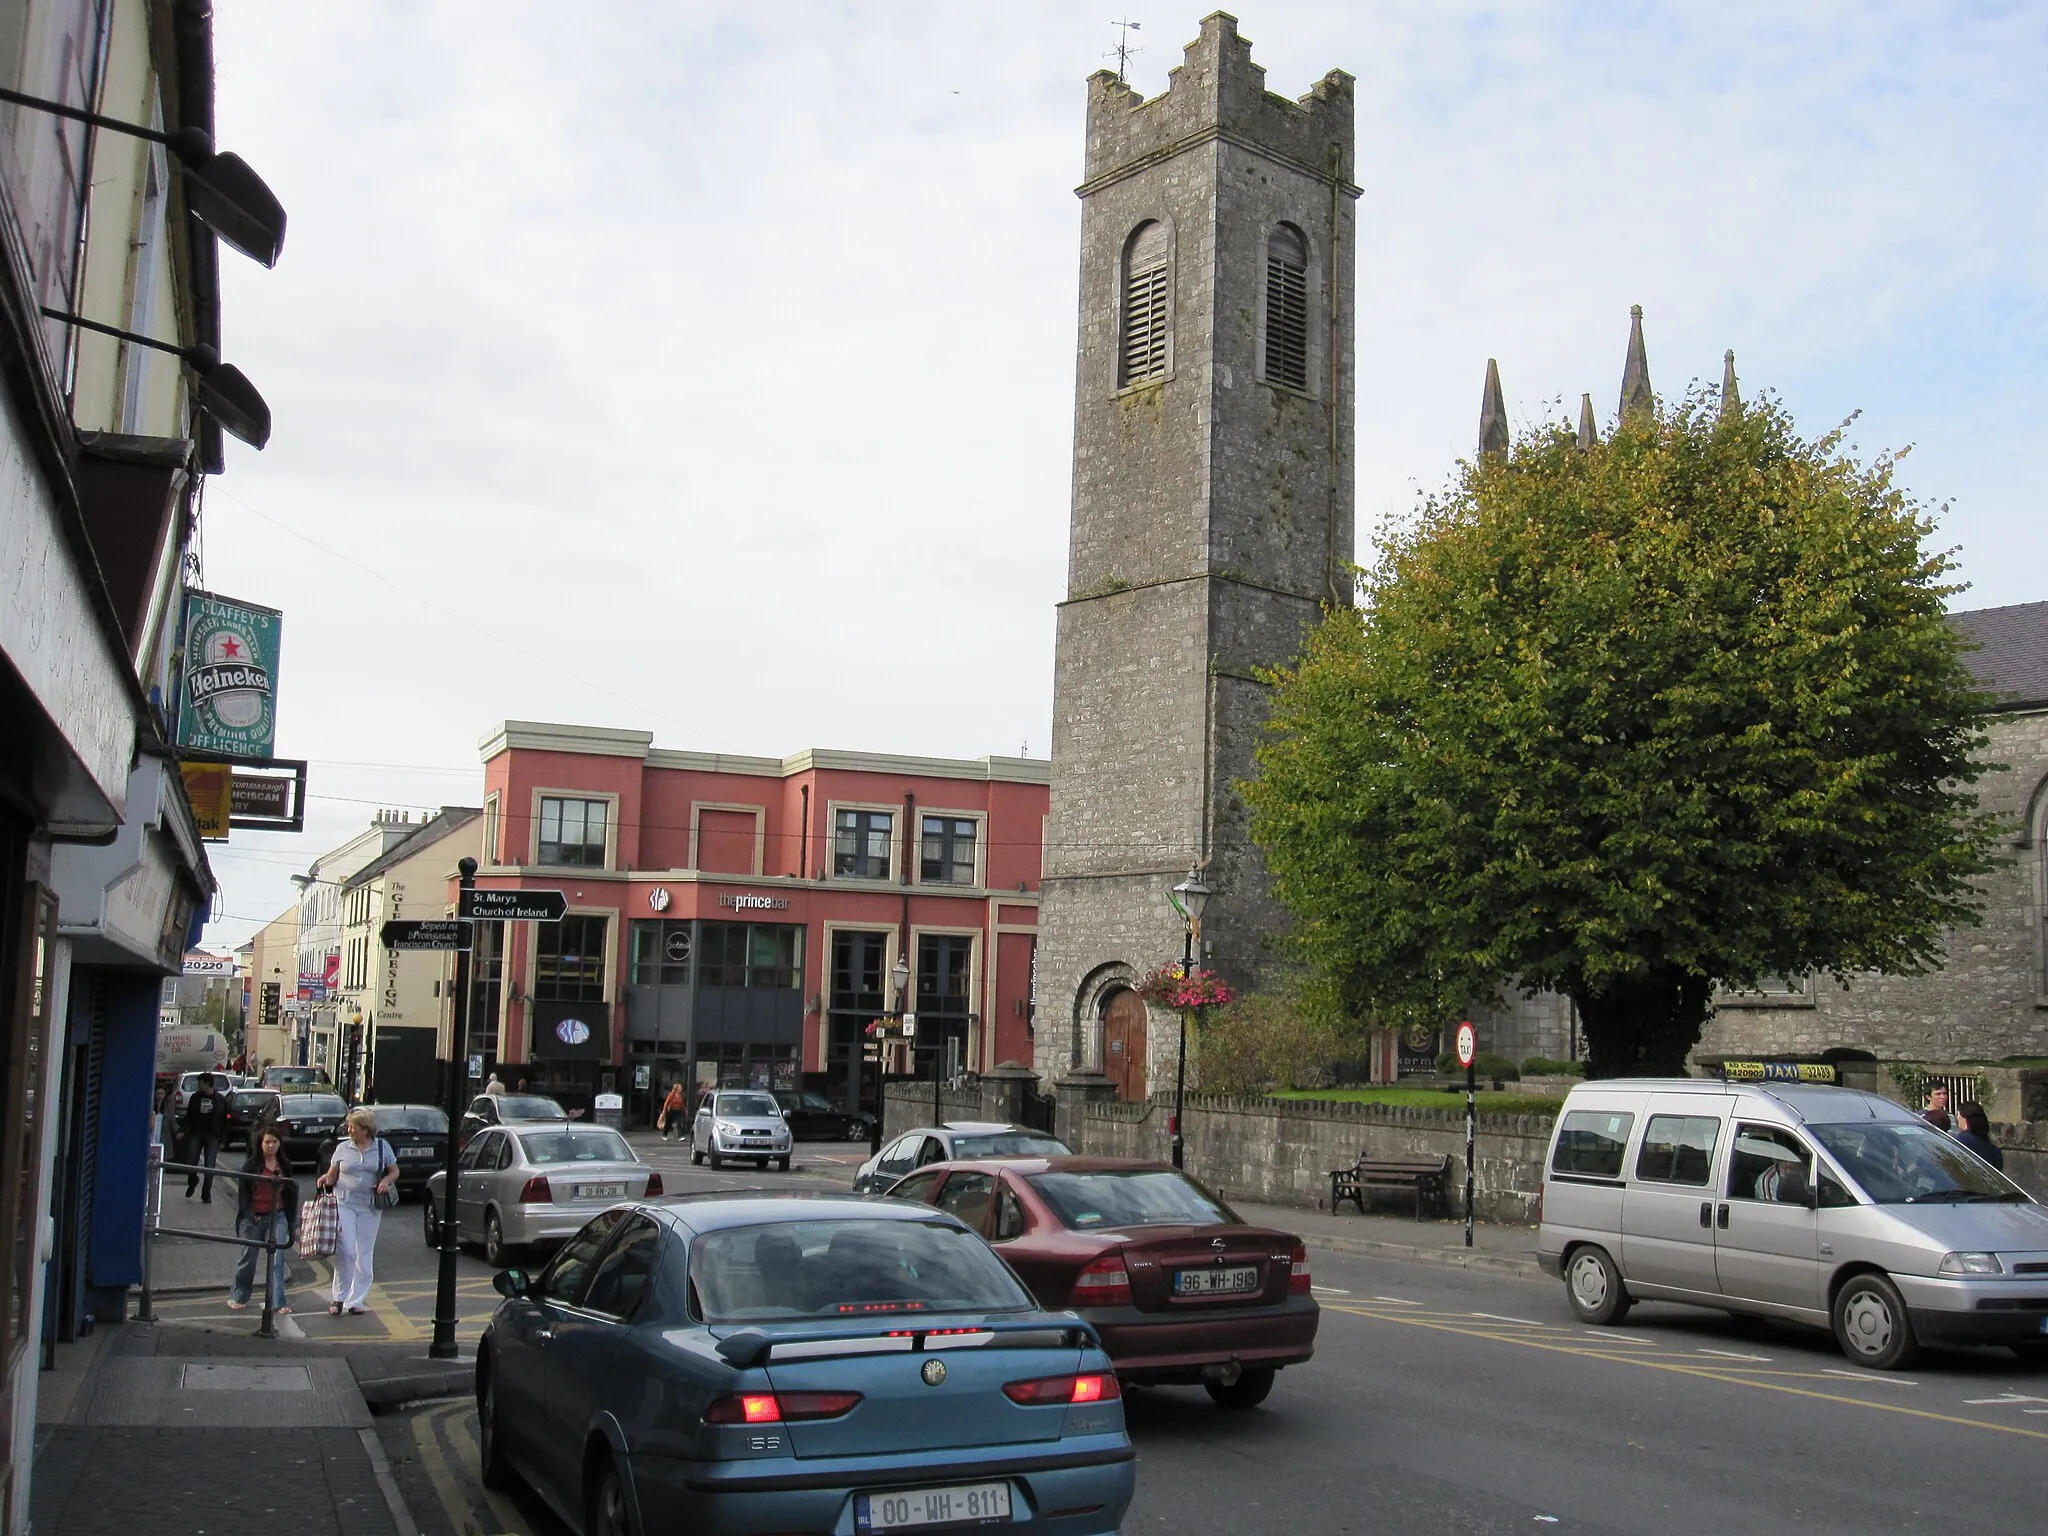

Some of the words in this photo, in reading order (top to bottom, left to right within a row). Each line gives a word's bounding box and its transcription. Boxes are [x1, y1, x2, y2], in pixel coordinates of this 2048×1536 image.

[190, 667, 271, 697] Heineken
[213, 738, 262, 756] LICENCE
[473, 907, 504, 917] Church
[505, 907, 515, 917] of
[517, 907, 548, 918] Ireland
[384, 950, 400, 1007] DESIGN
[377, 1010, 403, 1020] Centre
[1727, 1068, 1764, 1077] 6420902
[1765, 1064, 1798, 1078] TAXI
[1807, 1066, 1831, 1079] 32489
